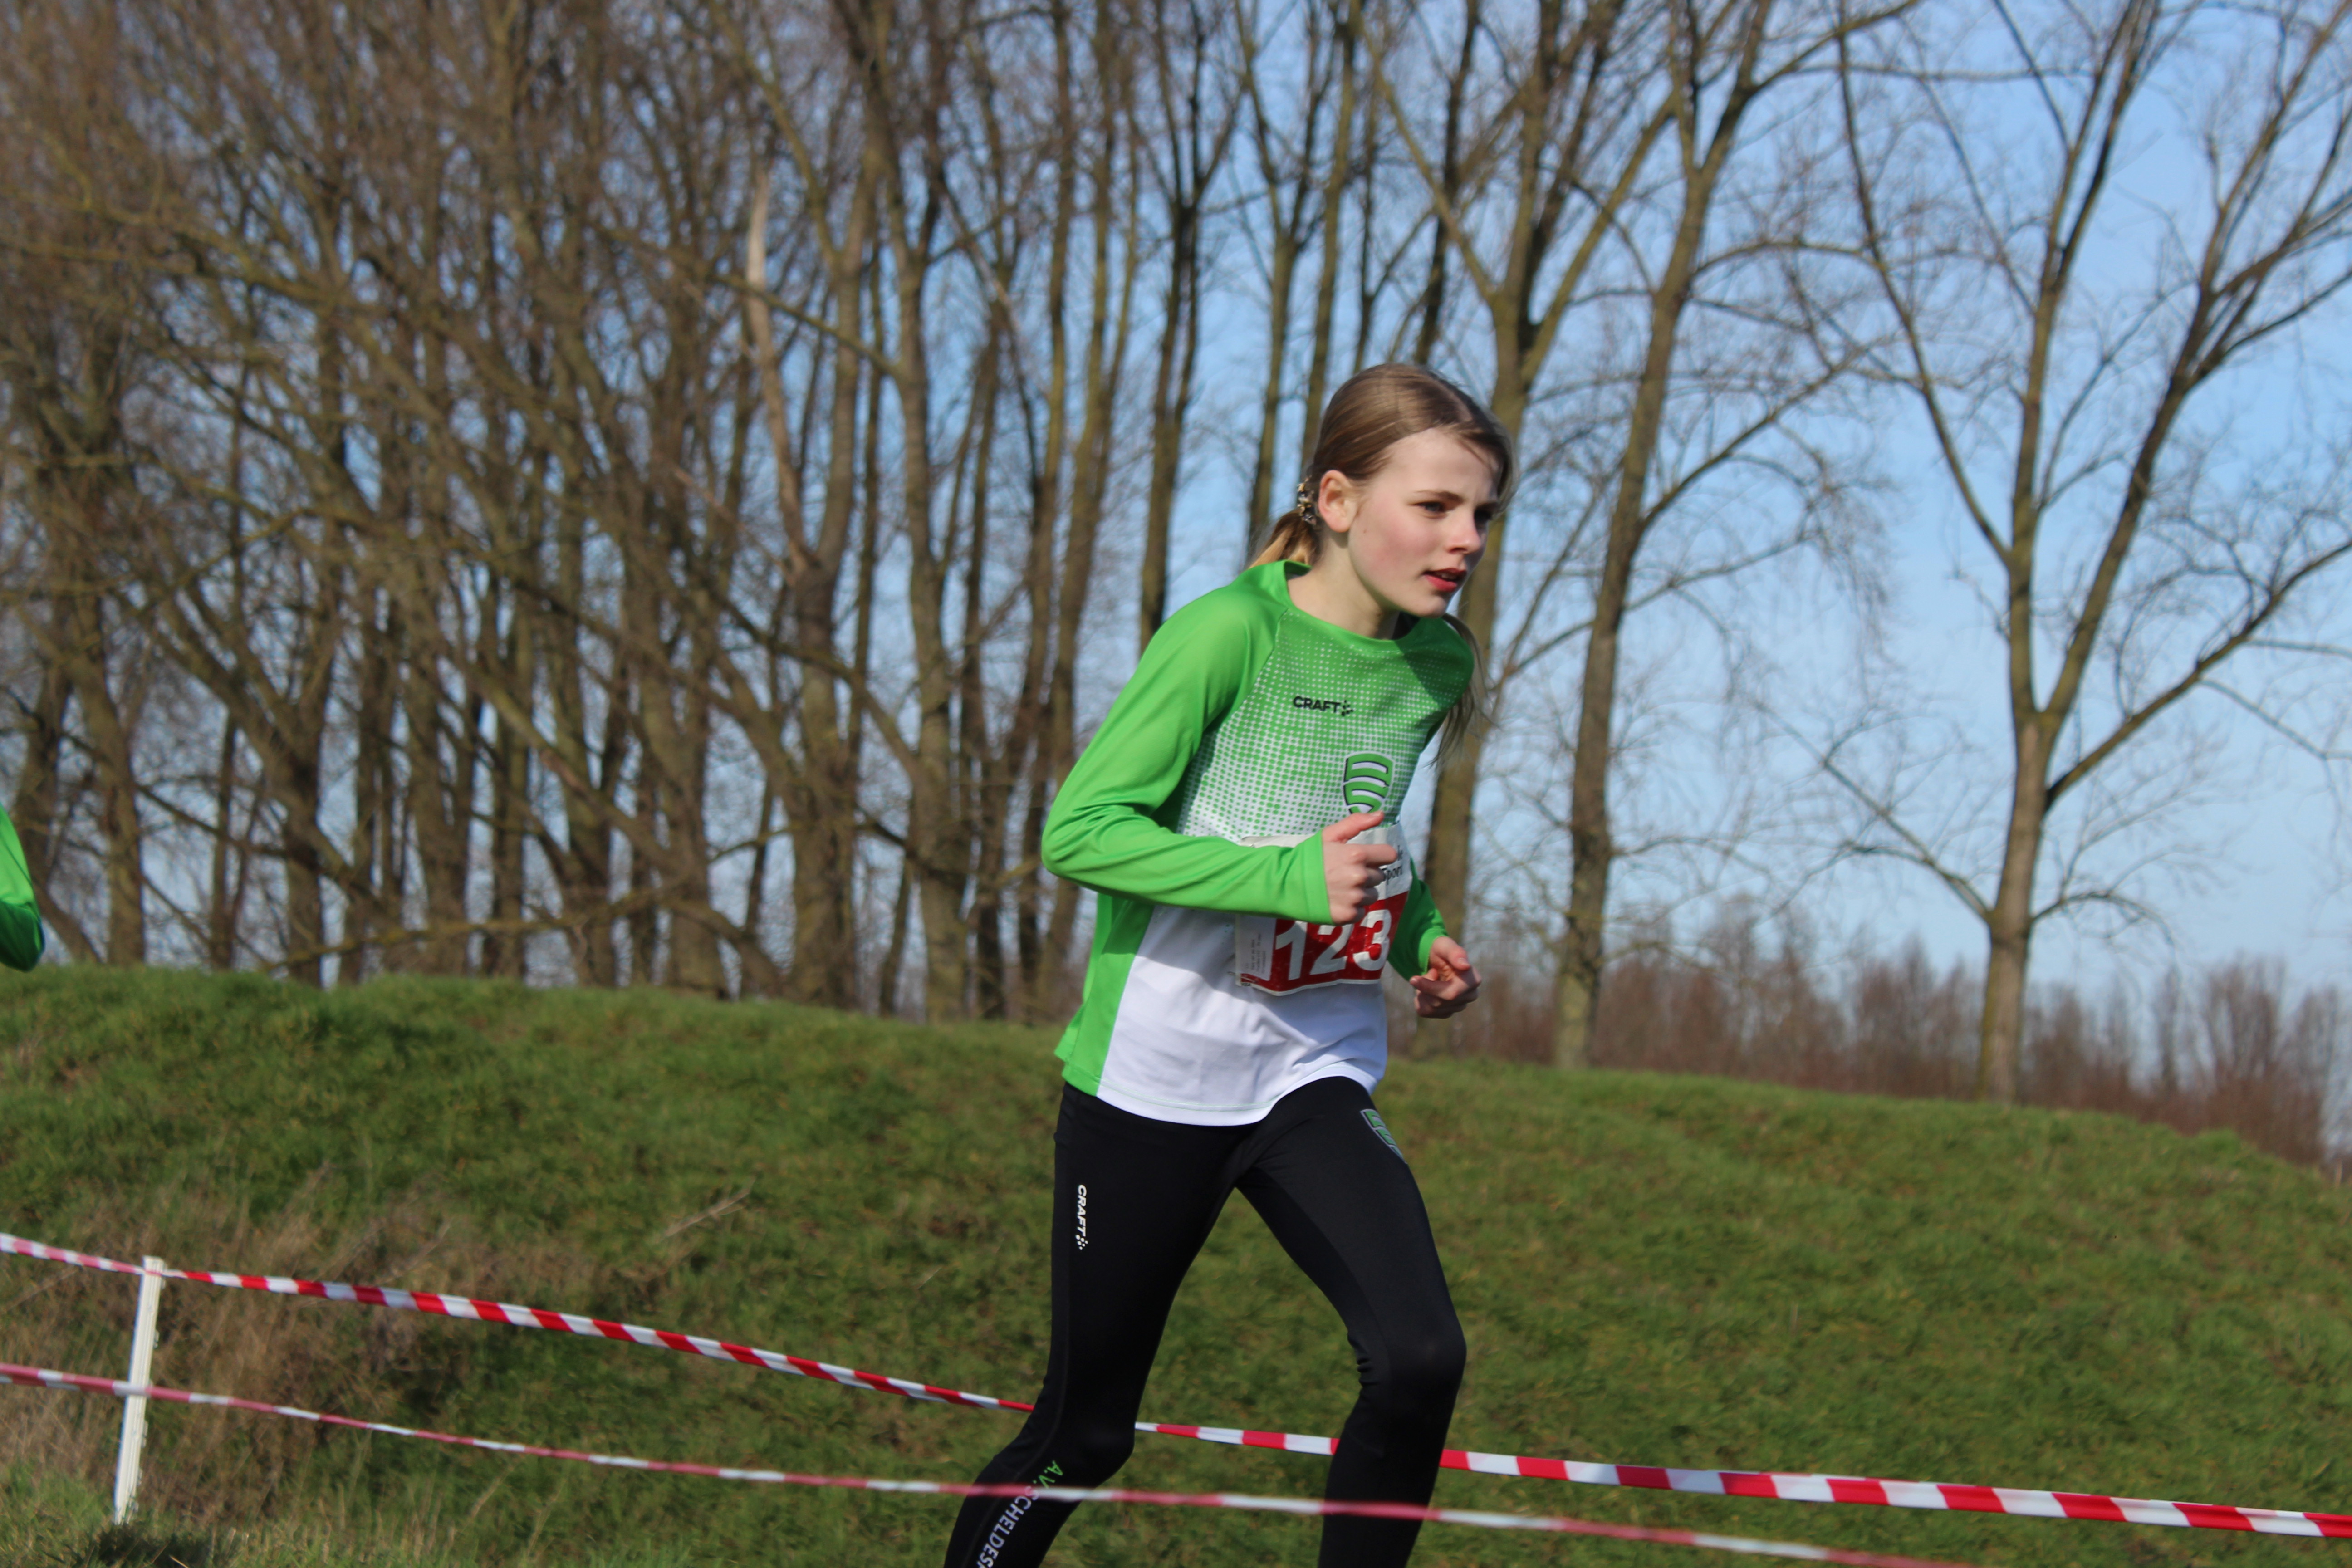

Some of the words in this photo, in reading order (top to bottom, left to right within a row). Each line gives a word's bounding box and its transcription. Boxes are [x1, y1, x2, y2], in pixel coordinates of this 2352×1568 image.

[1294, 696, 1341, 713] CRAFT
[1275, 909, 1392, 980] 123
[1078, 1184, 1087, 1237] CRAFT
